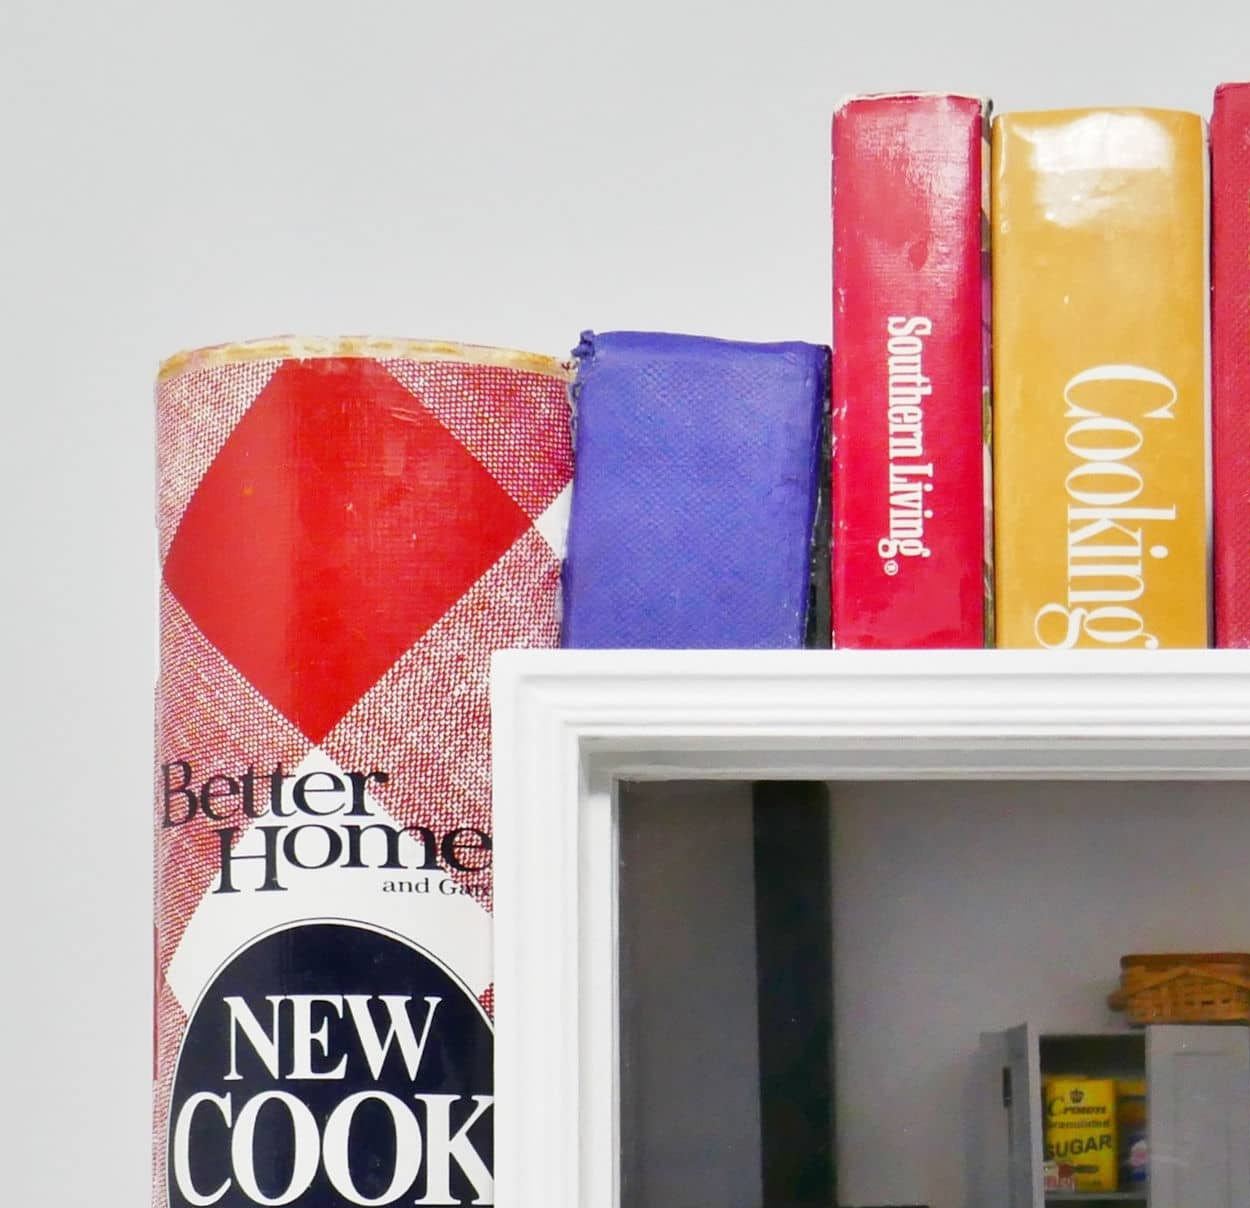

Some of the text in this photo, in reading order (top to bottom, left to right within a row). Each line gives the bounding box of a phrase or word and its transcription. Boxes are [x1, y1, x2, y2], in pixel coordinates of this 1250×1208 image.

[886, 315, 933, 459] Southern
[1034, 364, 1178, 648] Cooking
[161, 760, 388, 828] Better
[382, 877, 430, 894] and
[223, 994, 443, 1081] NEW
[174, 1090, 494, 1206] COOK
